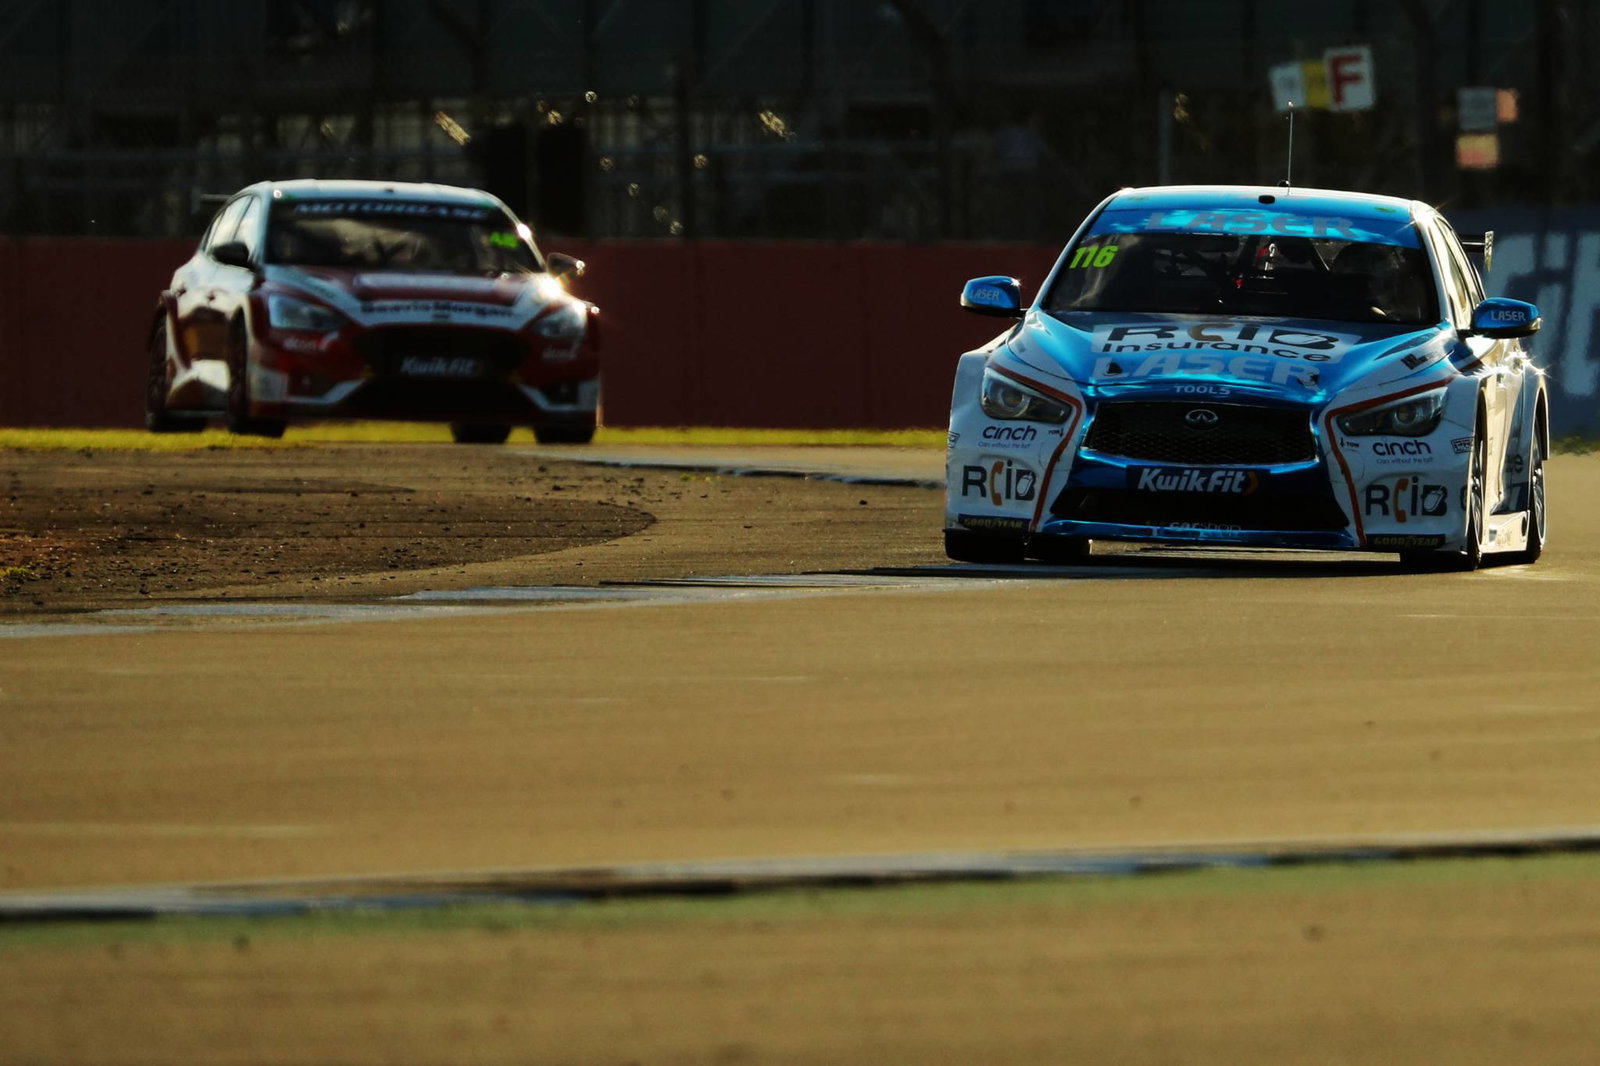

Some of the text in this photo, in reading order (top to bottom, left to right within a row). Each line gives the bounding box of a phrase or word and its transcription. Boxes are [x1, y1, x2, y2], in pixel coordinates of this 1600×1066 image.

[1329, 54, 1363, 104] F
[1145, 211, 1357, 238] LASER
[1069, 245, 1118, 269] 116
[970, 287, 1000, 301] LASER
[1490, 310, 1526, 322] LASER
[1091, 352, 1322, 391] LASER
[1174, 384, 1231, 395] TOOLS
[982, 425, 1037, 441] cinch
[1372, 440, 1432, 456] cinch
